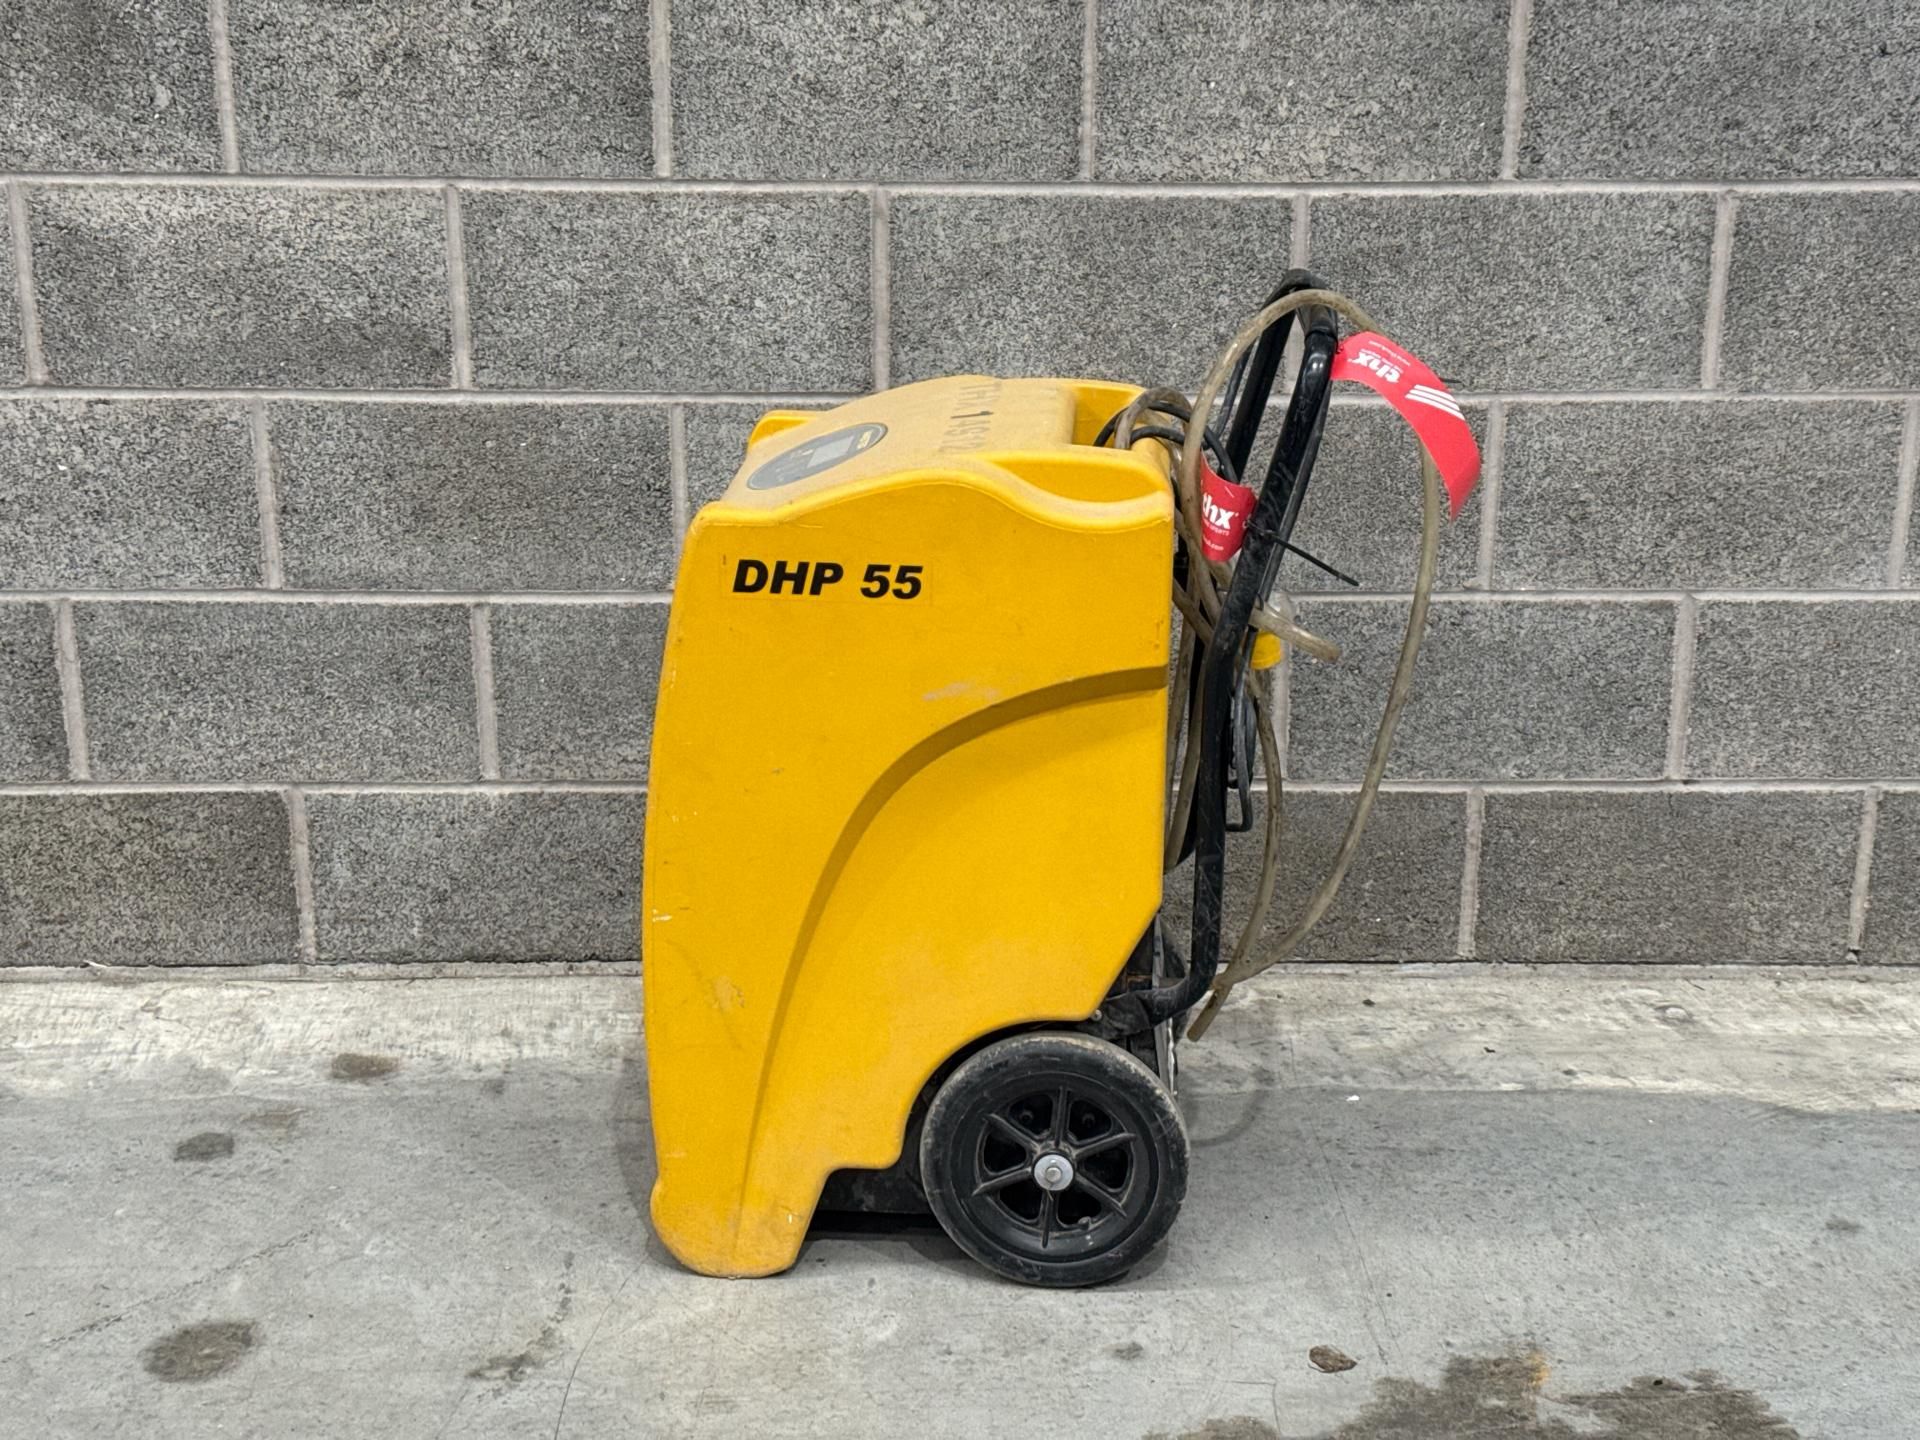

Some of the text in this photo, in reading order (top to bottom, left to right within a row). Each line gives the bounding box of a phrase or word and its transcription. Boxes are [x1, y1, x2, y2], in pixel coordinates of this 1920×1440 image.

[1352, 352, 1400, 383] thx
[733, 559, 923, 600] DHP 55
